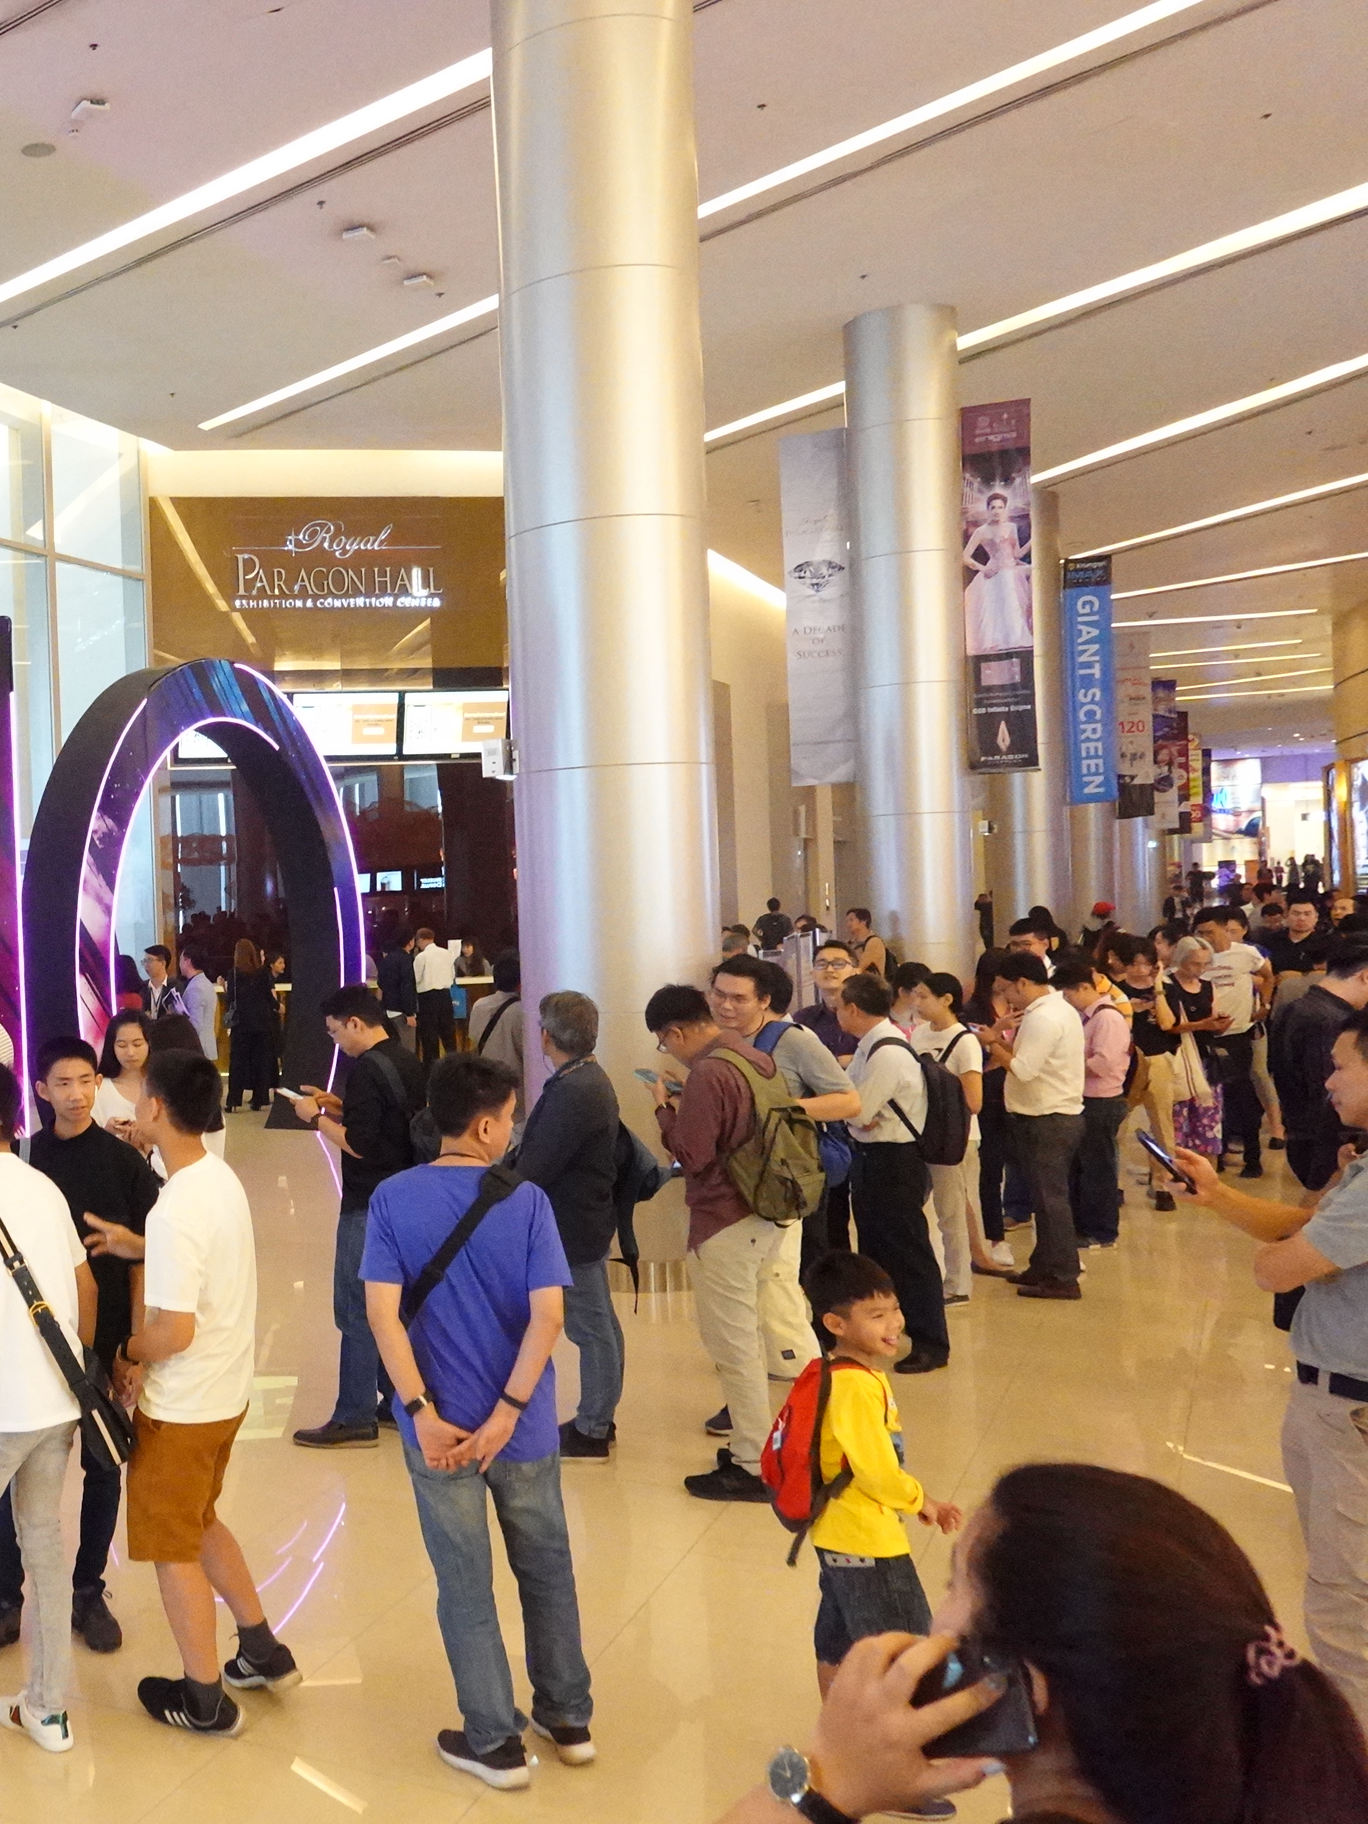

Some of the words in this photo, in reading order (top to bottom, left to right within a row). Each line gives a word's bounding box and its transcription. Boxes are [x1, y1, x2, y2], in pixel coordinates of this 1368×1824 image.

[286, 520, 393, 559] Royal
[234, 553, 365, 596] PARAGON
[374, 565, 443, 597] HALL
[235, 599, 302, 609] EXHIBITION
[305, 599, 314, 608] &
[317, 597, 393, 608] CONVENTION
[1076, 595, 1101, 679] GIANT
[1078, 687, 1106, 794] SCREEN
[1118, 719, 1146, 734] 120
